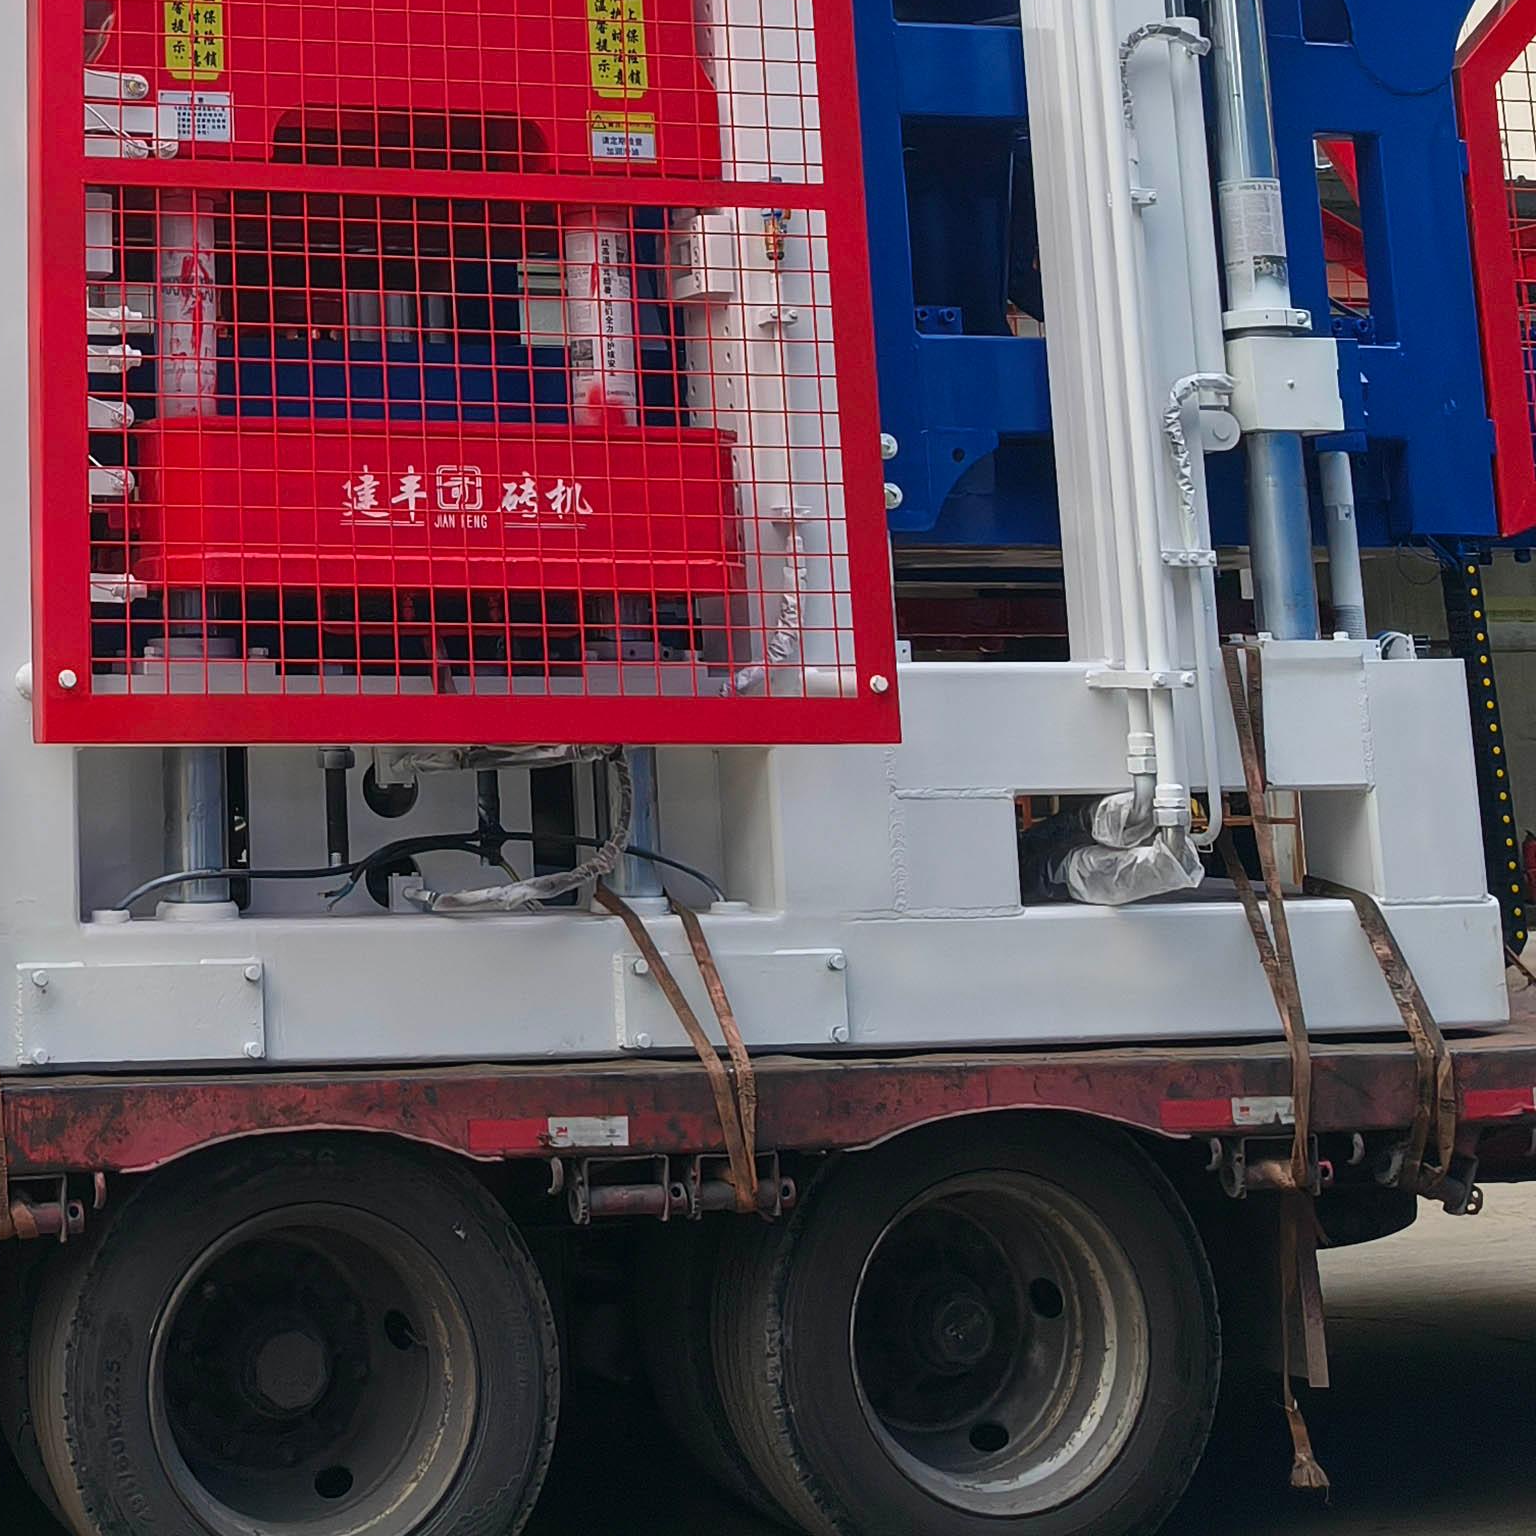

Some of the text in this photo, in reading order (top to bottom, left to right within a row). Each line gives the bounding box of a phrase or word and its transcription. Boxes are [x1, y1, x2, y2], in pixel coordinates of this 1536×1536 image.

[342, 465, 593, 522] 建丰 砖机
[434, 514, 455, 529] JIAN
